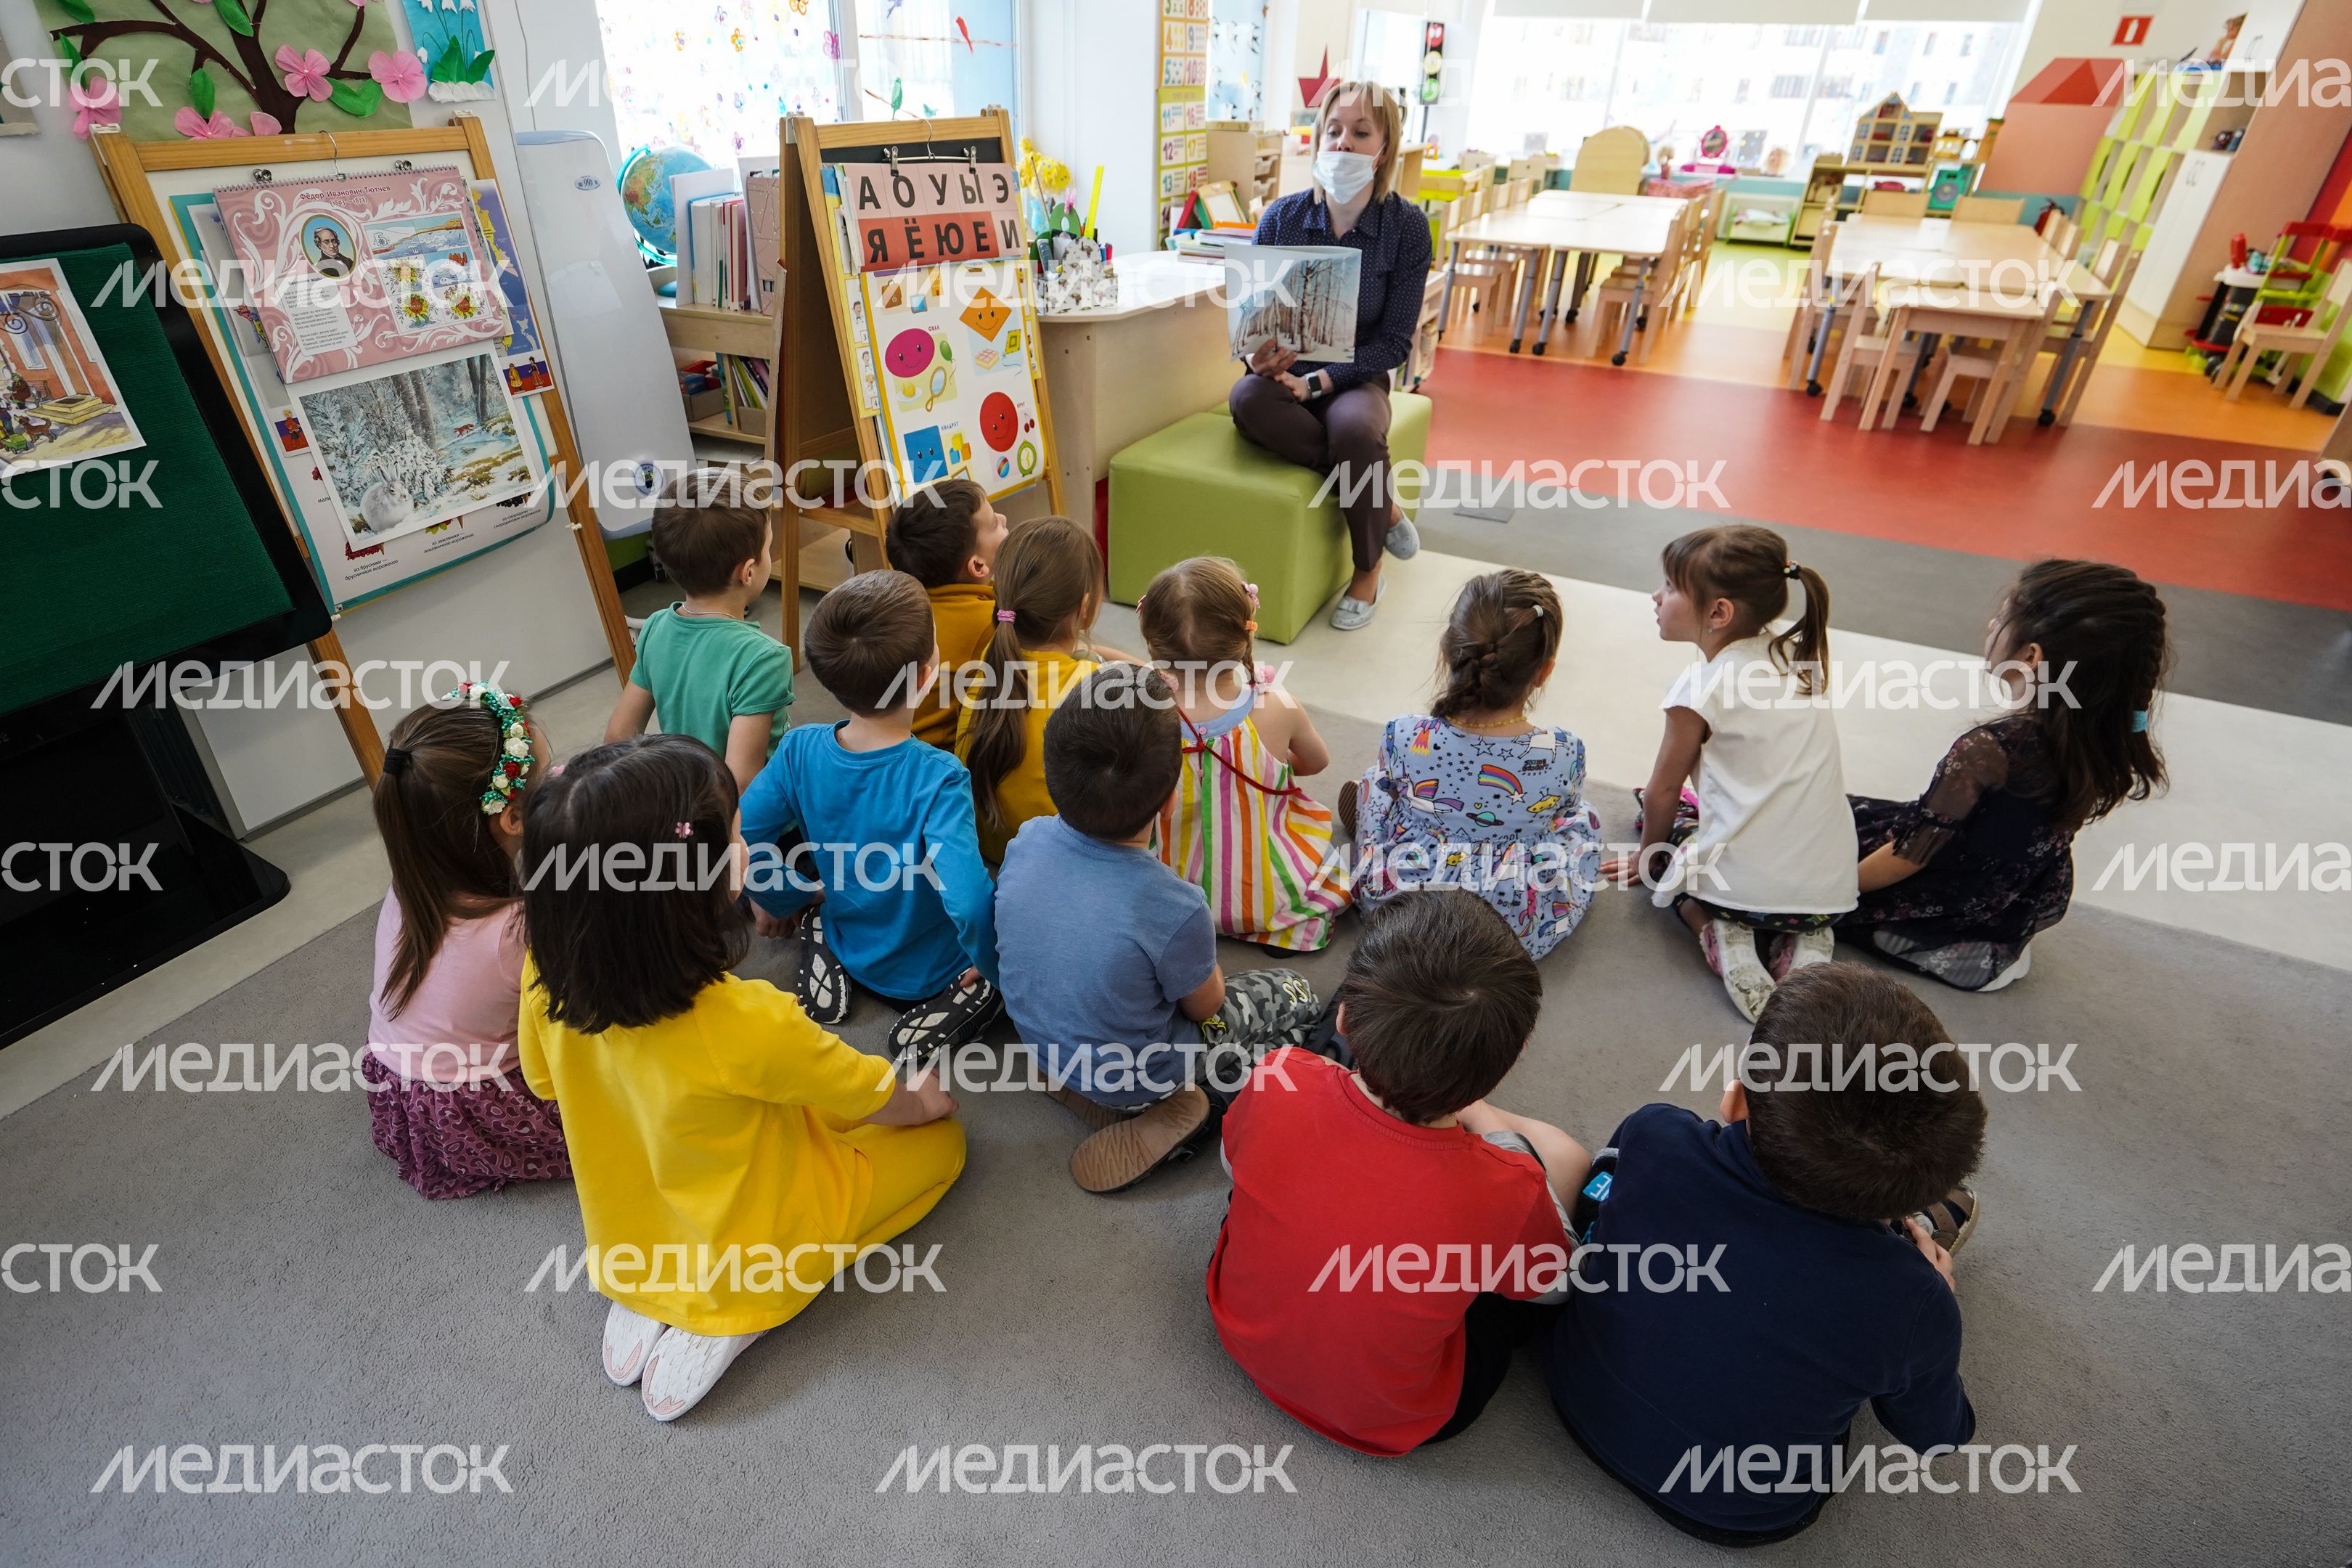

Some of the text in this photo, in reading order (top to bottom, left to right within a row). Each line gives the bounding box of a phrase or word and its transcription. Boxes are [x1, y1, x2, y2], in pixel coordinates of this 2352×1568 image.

[1188, 25, 1195, 51] 9
[1164, 58, 1172, 84] 5
[1187, 59, 1198, 84] 10
[1162, 107, 1172, 128] 11
[1163, 141, 1173, 160] 12
[1188, 138, 1196, 158] 17
[859, 173, 1010, 210] А О У Ы Э
[1162, 173, 1173, 193] 13
[300, 192, 324, 200] Фёдор
[326, 189, 362, 197] Иванович
[867, 217, 1021, 264] Я Ё Ю Е И
[345, 560, 399, 581] брусничное мороженое
[360, 560, 382, 571] брусники
